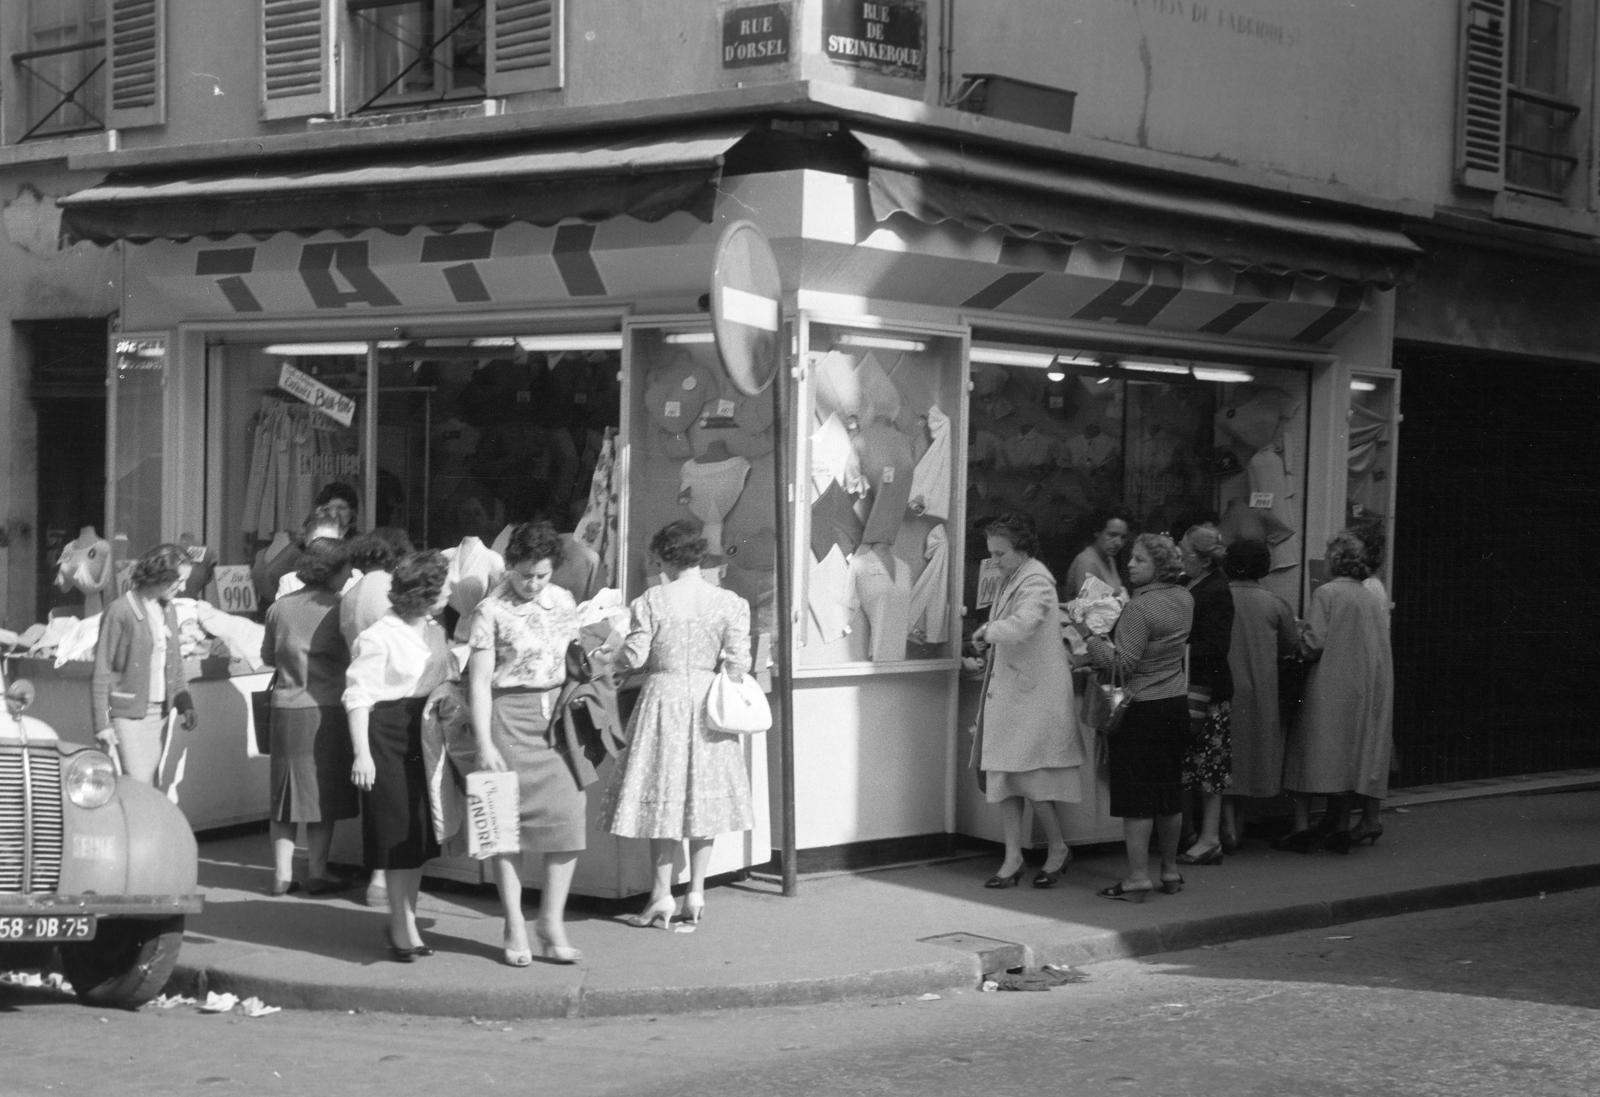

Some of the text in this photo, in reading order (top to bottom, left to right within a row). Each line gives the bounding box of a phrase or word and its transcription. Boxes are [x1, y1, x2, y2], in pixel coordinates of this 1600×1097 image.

[862, 2, 890, 23] RUE
[740, 16, 773, 36] RUE
[866, 21, 884, 41] DE
[724, 38, 787, 62] D'ORSEL
[828, 34, 921, 67] STEINKERQUE
[195, 224, 608, 313] TATI
[960, 235, 1364, 343] TATI
[223, 585, 252, 610] 990
